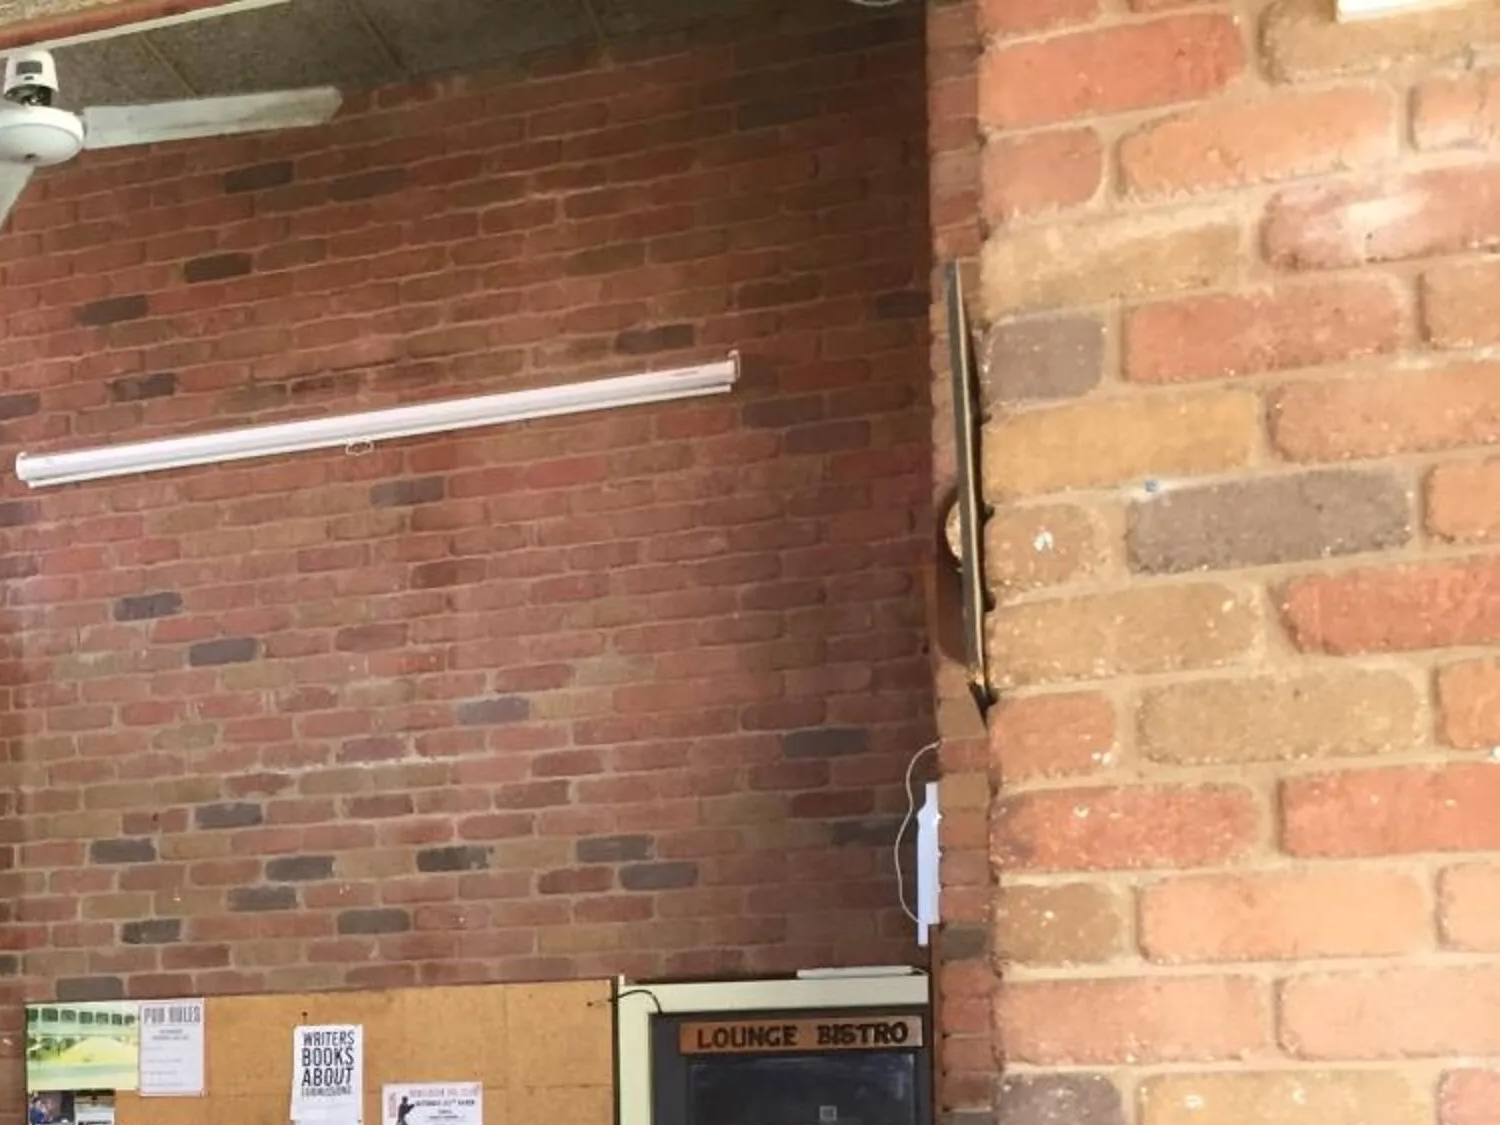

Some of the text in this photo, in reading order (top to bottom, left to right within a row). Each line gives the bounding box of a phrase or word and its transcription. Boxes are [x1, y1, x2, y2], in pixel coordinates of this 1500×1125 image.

[303, 1031, 355, 1046] WRITERS
[696, 1021, 909, 1048] LOUNGE BISTRO
[302, 1047, 355, 1067] BOOKS
[301, 1066, 354, 1086] ABOUT
